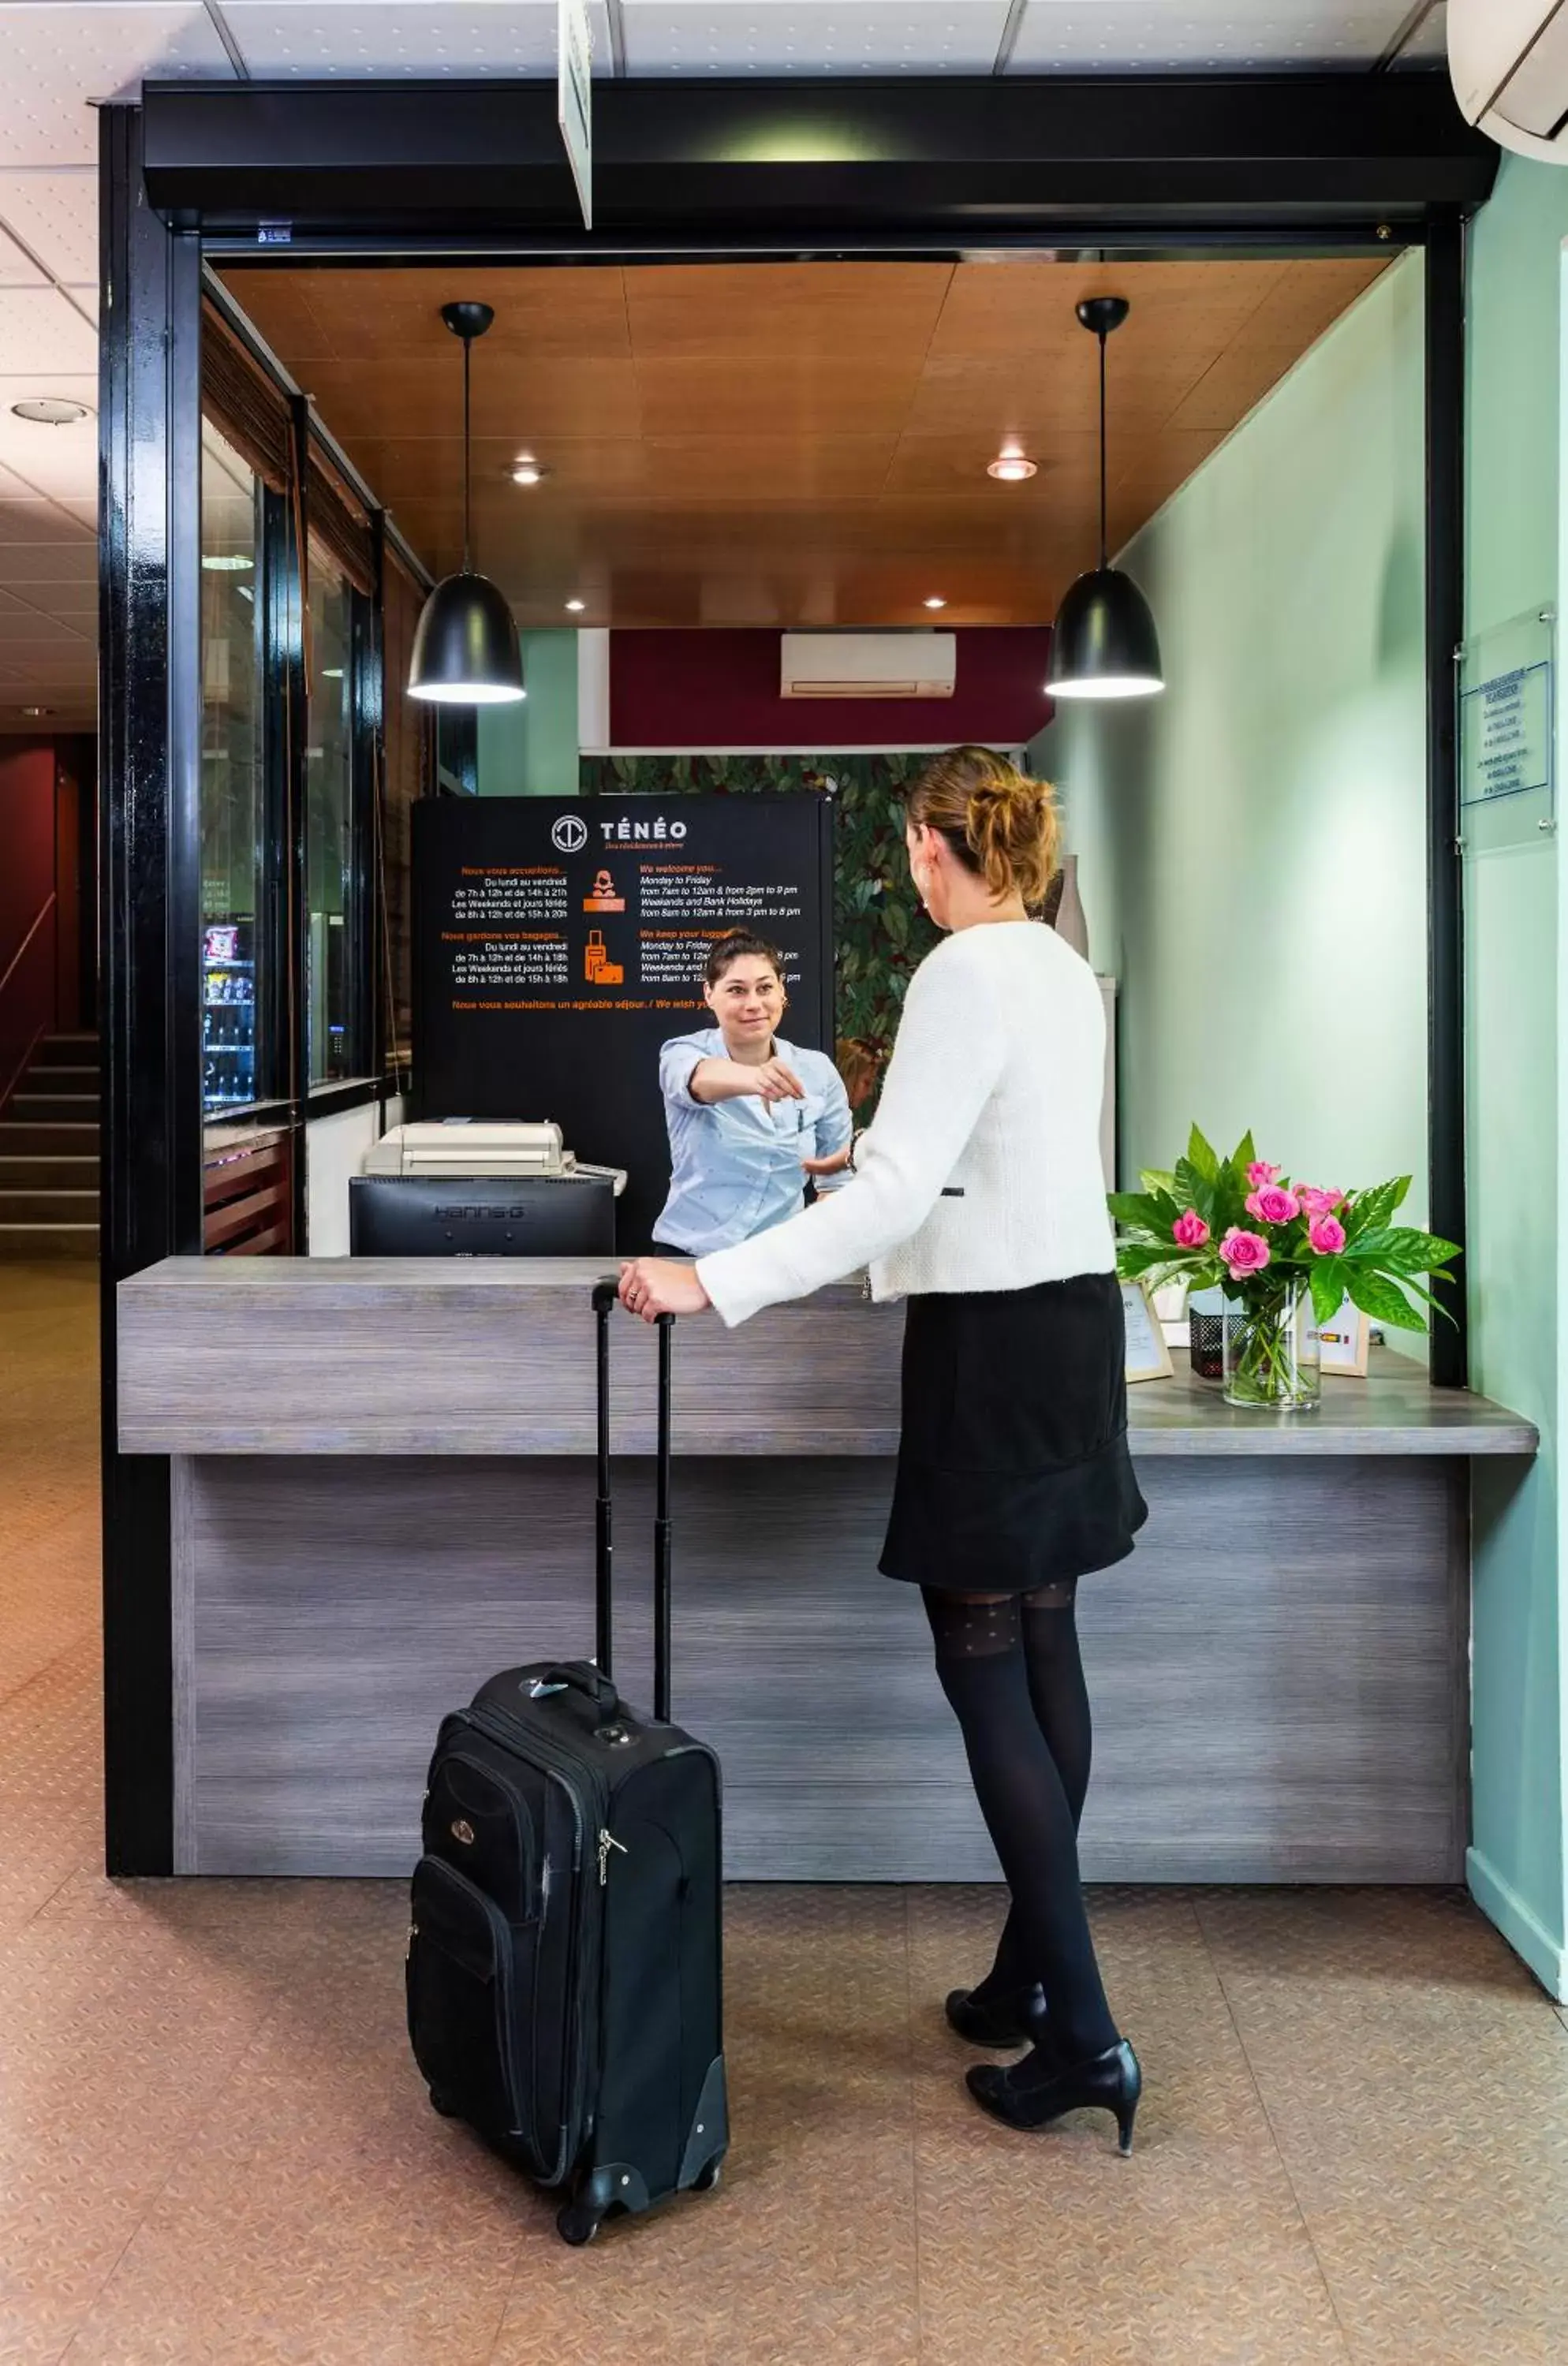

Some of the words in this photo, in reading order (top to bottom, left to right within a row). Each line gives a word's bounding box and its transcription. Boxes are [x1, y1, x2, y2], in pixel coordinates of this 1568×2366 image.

[600, 816, 687, 840] TÉNÉO
[461, 865, 484, 875] Nous
[487, 865, 507, 875] vous
[640, 864, 654, 874] We
[655, 864, 695, 874] welcome
[485, 878, 498, 886] Du
[498, 878, 517, 886] lundi
[520, 878, 531, 886] au
[533, 878, 567, 886] vendredi
[640, 876, 674, 885] Monday
[675, 876, 684, 885] to
[685, 876, 711, 885] Friday
[455, 889, 466, 898] de
[468, 889, 479, 898] 7h
[488, 889, 502, 898] 12h
[505, 889, 513, 898] et
[514, 889, 526, 898] de
[528, 889, 543, 898] 14h
[551, 889, 567, 898] 21h
[640, 886, 659, 895] from
[662, 886, 679, 895] 7am
[681, 886, 689, 895] to
[693, 886, 715, 895] 12am
[725, 886, 744, 895] from
[745, 886, 763, 895] 2pm
[767, 886, 775, 895] to
[784, 886, 797, 895] pm
[452, 899, 467, 909] Les
[468, 899, 512, 909] Weekends
[513, 899, 521, 909] et
[523, 899, 543, 909] jours
[545, 899, 567, 909] fériés
[640, 898, 684, 906] Weekends
[686, 898, 702, 906] and
[704, 898, 725, 906] Bank
[727, 898, 763, 906] Holidays
[455, 909, 466, 919] de
[488, 909, 502, 919] 12h
[505, 909, 513, 919] et
[514, 909, 526, 919] de
[528, 909, 543, 919] 15h
[640, 909, 659, 917] from
[681, 909, 689, 917] to
[693, 909, 715, 917] 12am
[725, 909, 744, 917] from
[753, 909, 767, 917] pm
[769, 909, 778, 917] to
[786, 909, 801, 917] pm
[441, 931, 465, 941] Nous
[466, 931, 502, 941] gardons
[504, 931, 521, 941] vos
[640, 930, 654, 939] We
[655, 930, 678, 939] keep
[679, 930, 700, 939] your
[640, 942, 674, 950] Monday
[676, 942, 684, 950] to
[685, 942, 712, 950] Friday
[455, 953, 466, 962] de
[468, 953, 479, 962] 7h
[488, 953, 503, 962] 12h
[505, 953, 513, 962] et
[514, 953, 526, 962] de
[528, 953, 543, 962] 14h
[640, 952, 659, 961] from
[662, 952, 680, 961] 7am
[681, 952, 689, 961] to
[784, 952, 799, 961] pm
[452, 965, 467, 973] Les
[468, 965, 512, 973] Weekends
[513, 965, 521, 973] et
[523, 965, 543, 973] jours
[545, 965, 568, 973] fériés
[641, 963, 685, 972] Weekends
[686, 963, 702, 972] and
[455, 975, 466, 983] de
[489, 975, 503, 983] 12h
[505, 975, 513, 983] et
[514, 975, 526, 983] de
[528, 975, 543, 983] 15h
[640, 974, 660, 983] from
[681, 974, 690, 983] to
[786, 974, 801, 983] pm
[452, 1000, 476, 1009] Nous
[479, 1000, 502, 1009] vous
[504, 1000, 555, 1009] souhaitons
[558, 1000, 569, 1009] un
[573, 1000, 612, 1009] agréable
[655, 1000, 670, 1009] We
[673, 1000, 695, 1009] wish
